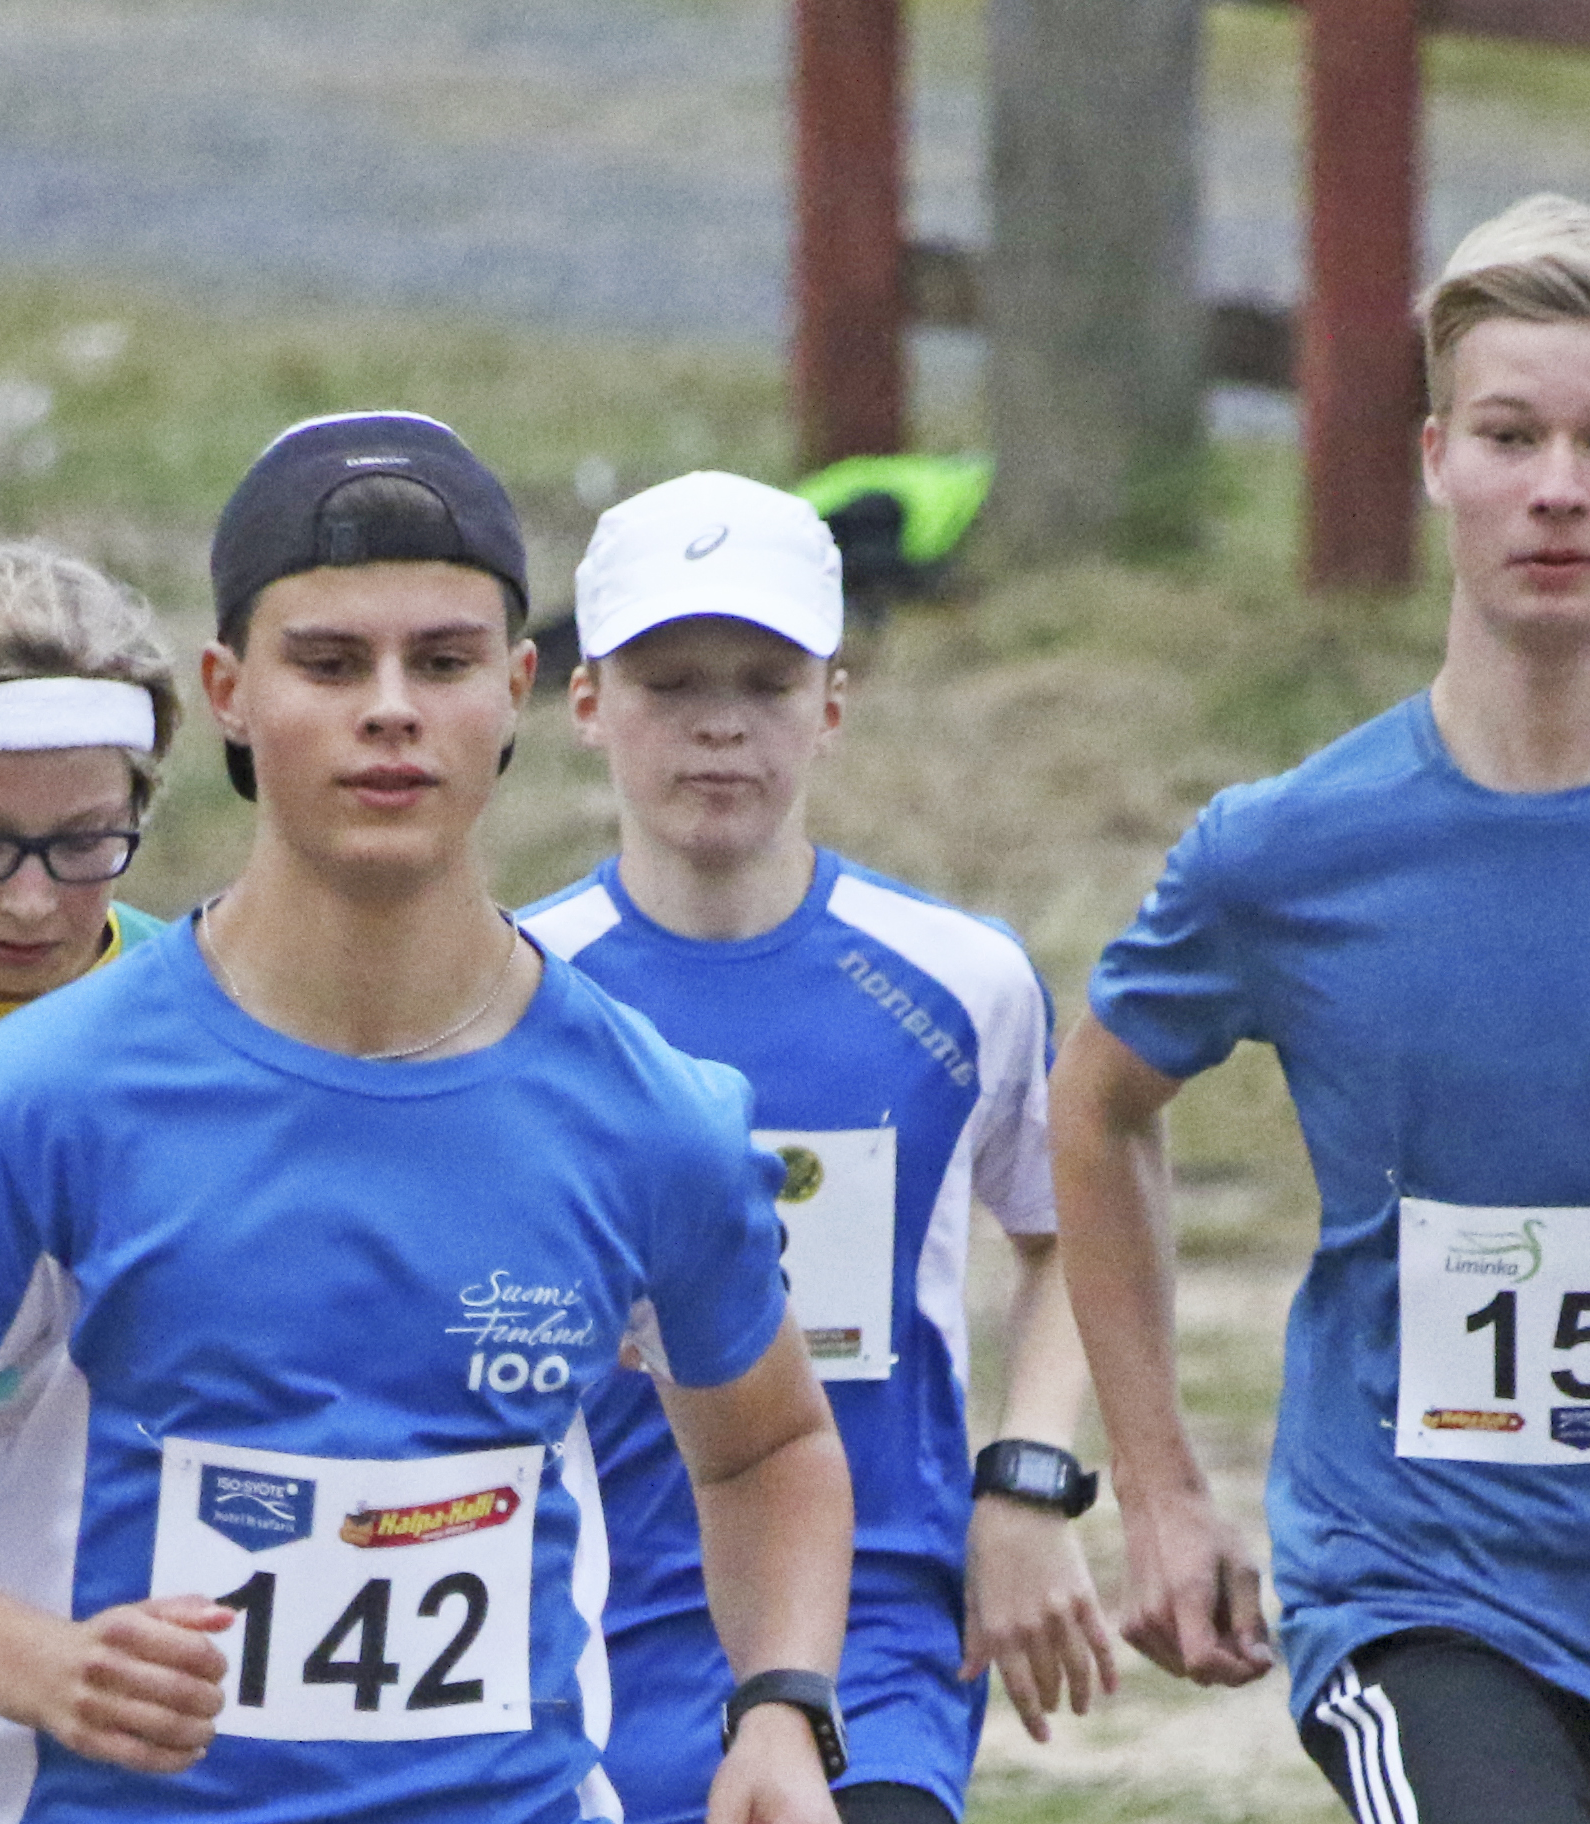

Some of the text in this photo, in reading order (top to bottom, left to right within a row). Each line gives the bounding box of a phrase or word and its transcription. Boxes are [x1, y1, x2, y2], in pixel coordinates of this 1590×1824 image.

[1444, 1256, 1519, 1277] Liminka
[460, 1270, 583, 1307] Suomi
[444, 1308, 594, 1346] Finland
[468, 1352, 570, 1393] 100
[214, 1570, 489, 1712] 142
